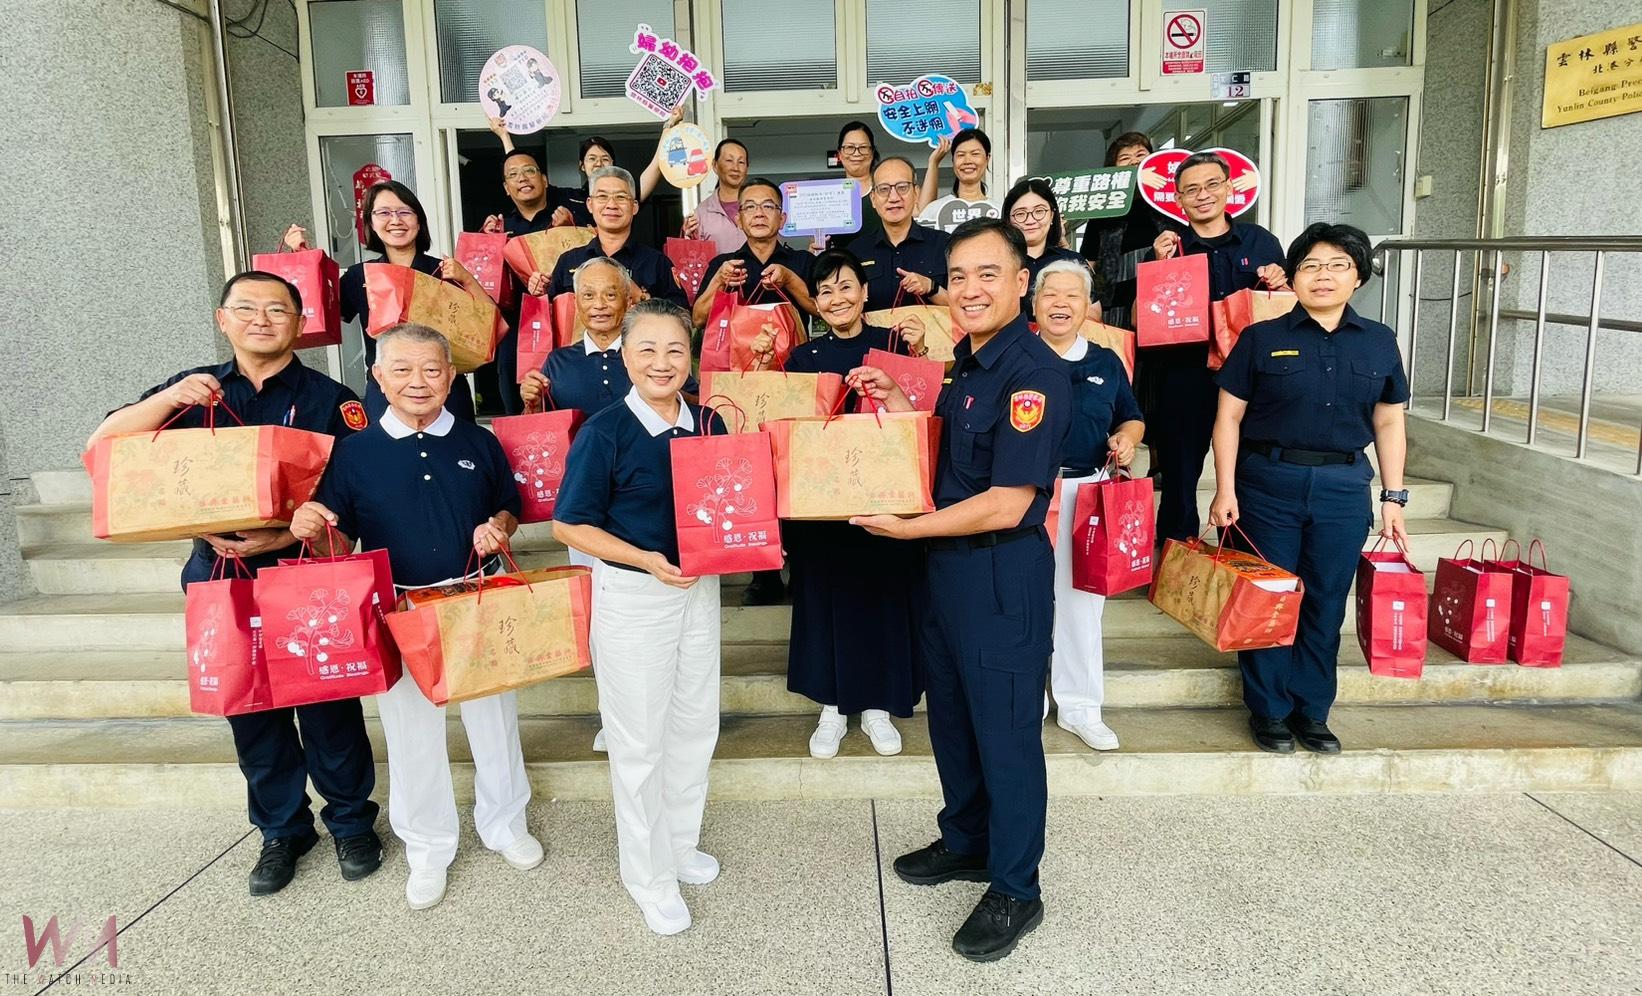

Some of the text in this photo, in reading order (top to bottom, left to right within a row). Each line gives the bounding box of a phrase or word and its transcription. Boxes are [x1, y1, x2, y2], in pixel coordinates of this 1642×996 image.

[637, 32, 714, 91] 婦幼抱抱
[883, 101, 939, 120] 安全上網
[1587, 96, 1617, 107] County
[1051, 170, 1132, 195] 尊重路權
